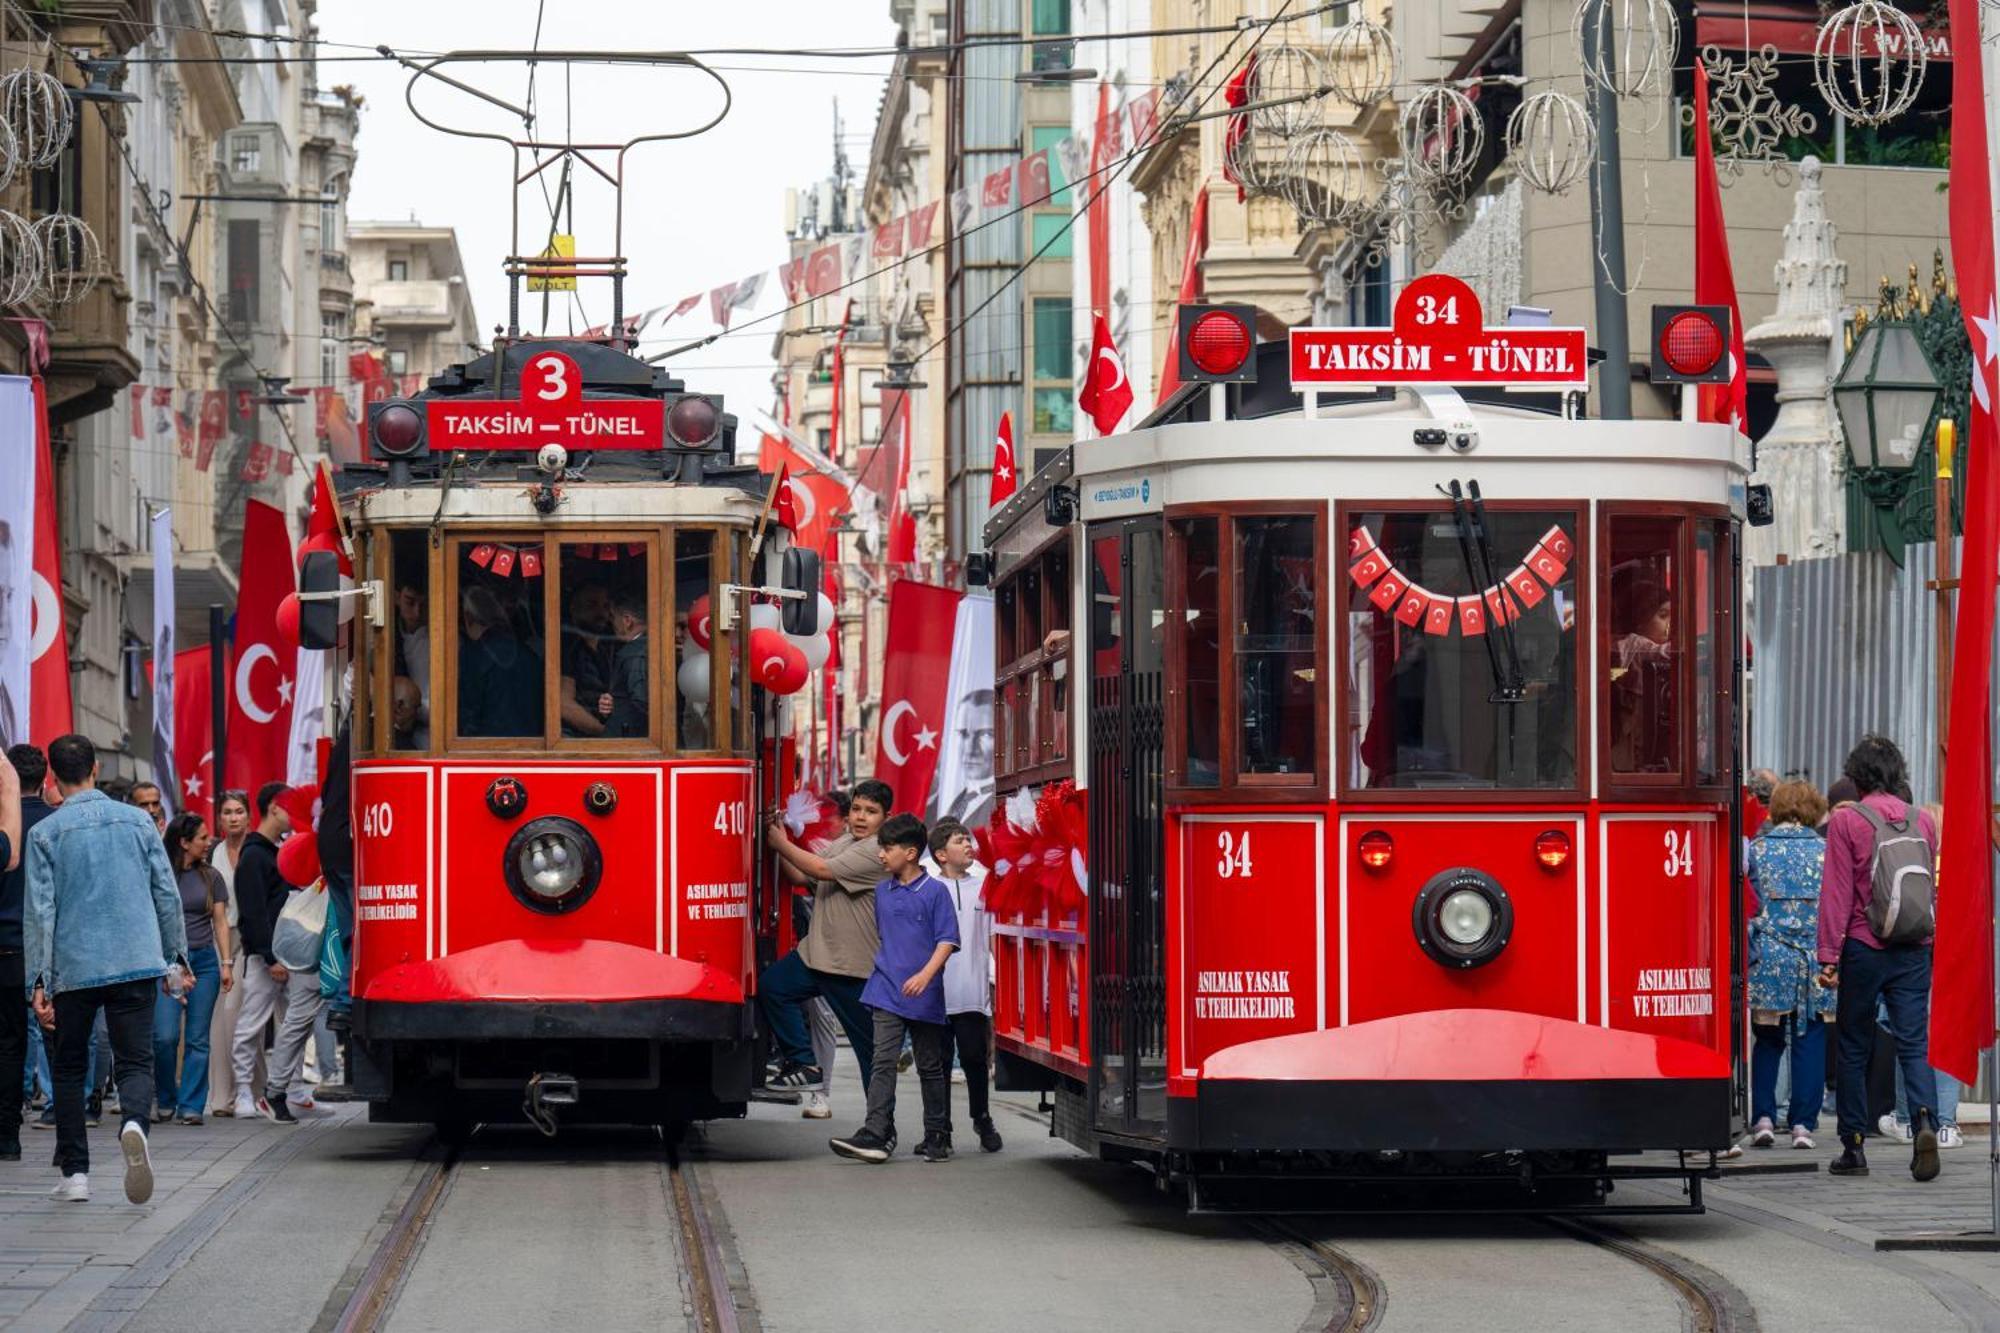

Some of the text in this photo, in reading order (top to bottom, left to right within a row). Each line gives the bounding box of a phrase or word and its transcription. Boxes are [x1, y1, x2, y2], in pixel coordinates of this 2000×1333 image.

[1415, 296, 1460, 325] 34
[1305, 337, 1431, 371] TAKSİM
[1468, 339, 1574, 373] TÜNEL
[536, 356, 568, 401] 3
[444, 412, 533, 434] TAKSİM
[566, 413, 645, 435] TÜNEL
[364, 802, 393, 837] 410
[714, 802, 745, 835] 410
[1218, 830, 1253, 878] 34
[1664, 830, 1693, 877] 34
[385, 884, 418, 899] YASAK
[686, 883, 729, 900] ASILMAK
[688, 905, 701, 920] VE
[1197, 971, 1290, 993] ASILMAK YASAK
[1637, 969, 1687, 992] ASILMAK
[1195, 997, 1206, 1018] VE
[1632, 995, 1650, 1017] VE
